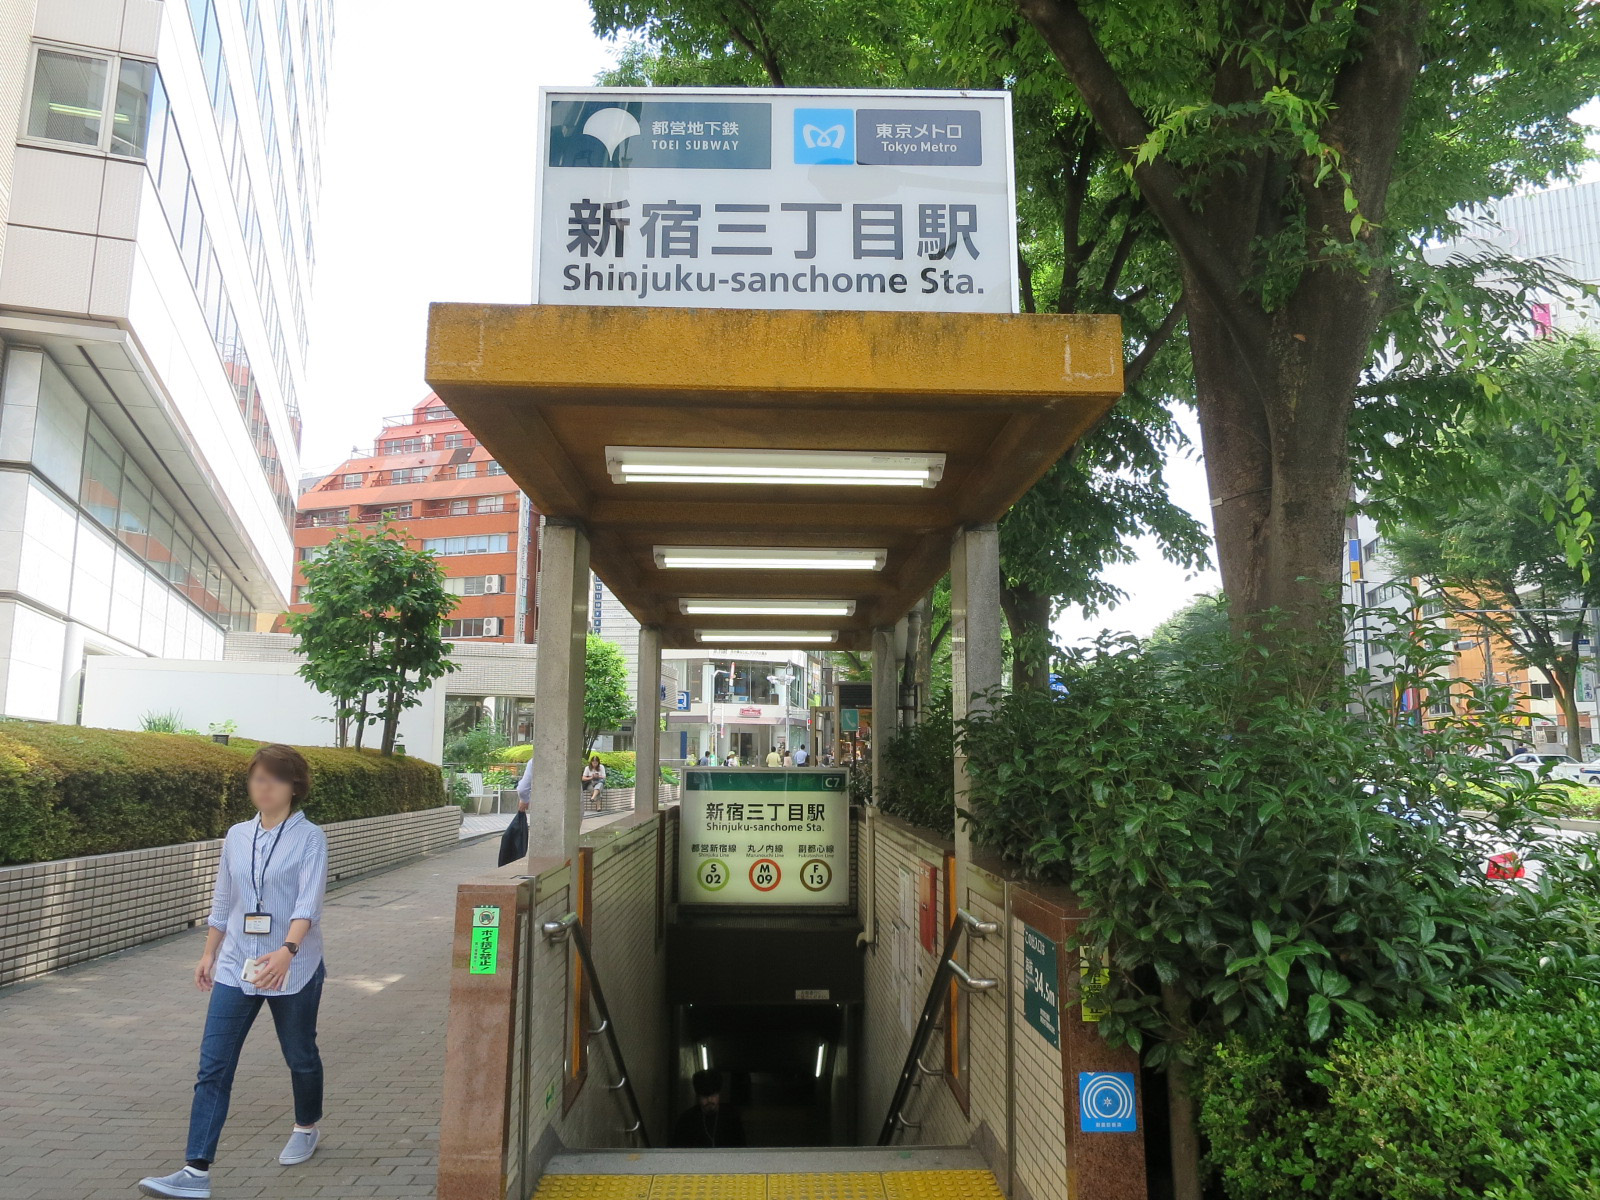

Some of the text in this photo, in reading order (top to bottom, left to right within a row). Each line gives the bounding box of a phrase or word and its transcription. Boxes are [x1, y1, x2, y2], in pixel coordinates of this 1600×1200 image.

[651, 120, 739, 136] 都営地下鉄
[875, 123, 962, 139] 東京メトロ
[651, 140, 739, 151] TOEI SUBWAY
[881, 141, 957, 154] Tokyo Metro
[566, 198, 981, 261] 新宿三丁目駅
[563, 263, 984, 299] Shinjuku-sanchome Sta.
[825, 777, 840, 788] C7
[706, 802, 825, 822] 新宿三丁目駅
[706, 822, 825, 833] Shinjuku-sanchome Sta.
[691, 844, 737, 853] 都営新宿線
[747, 844, 784, 853] 丸ノ内線
[798, 844, 835, 854] 副都心線
[710, 864, 717, 873] S
[759, 864, 770, 873] M
[813, 864, 819, 873] F
[705, 874, 721, 884] 02
[757, 874, 773, 884] 09
[810, 875, 824, 885] 13
